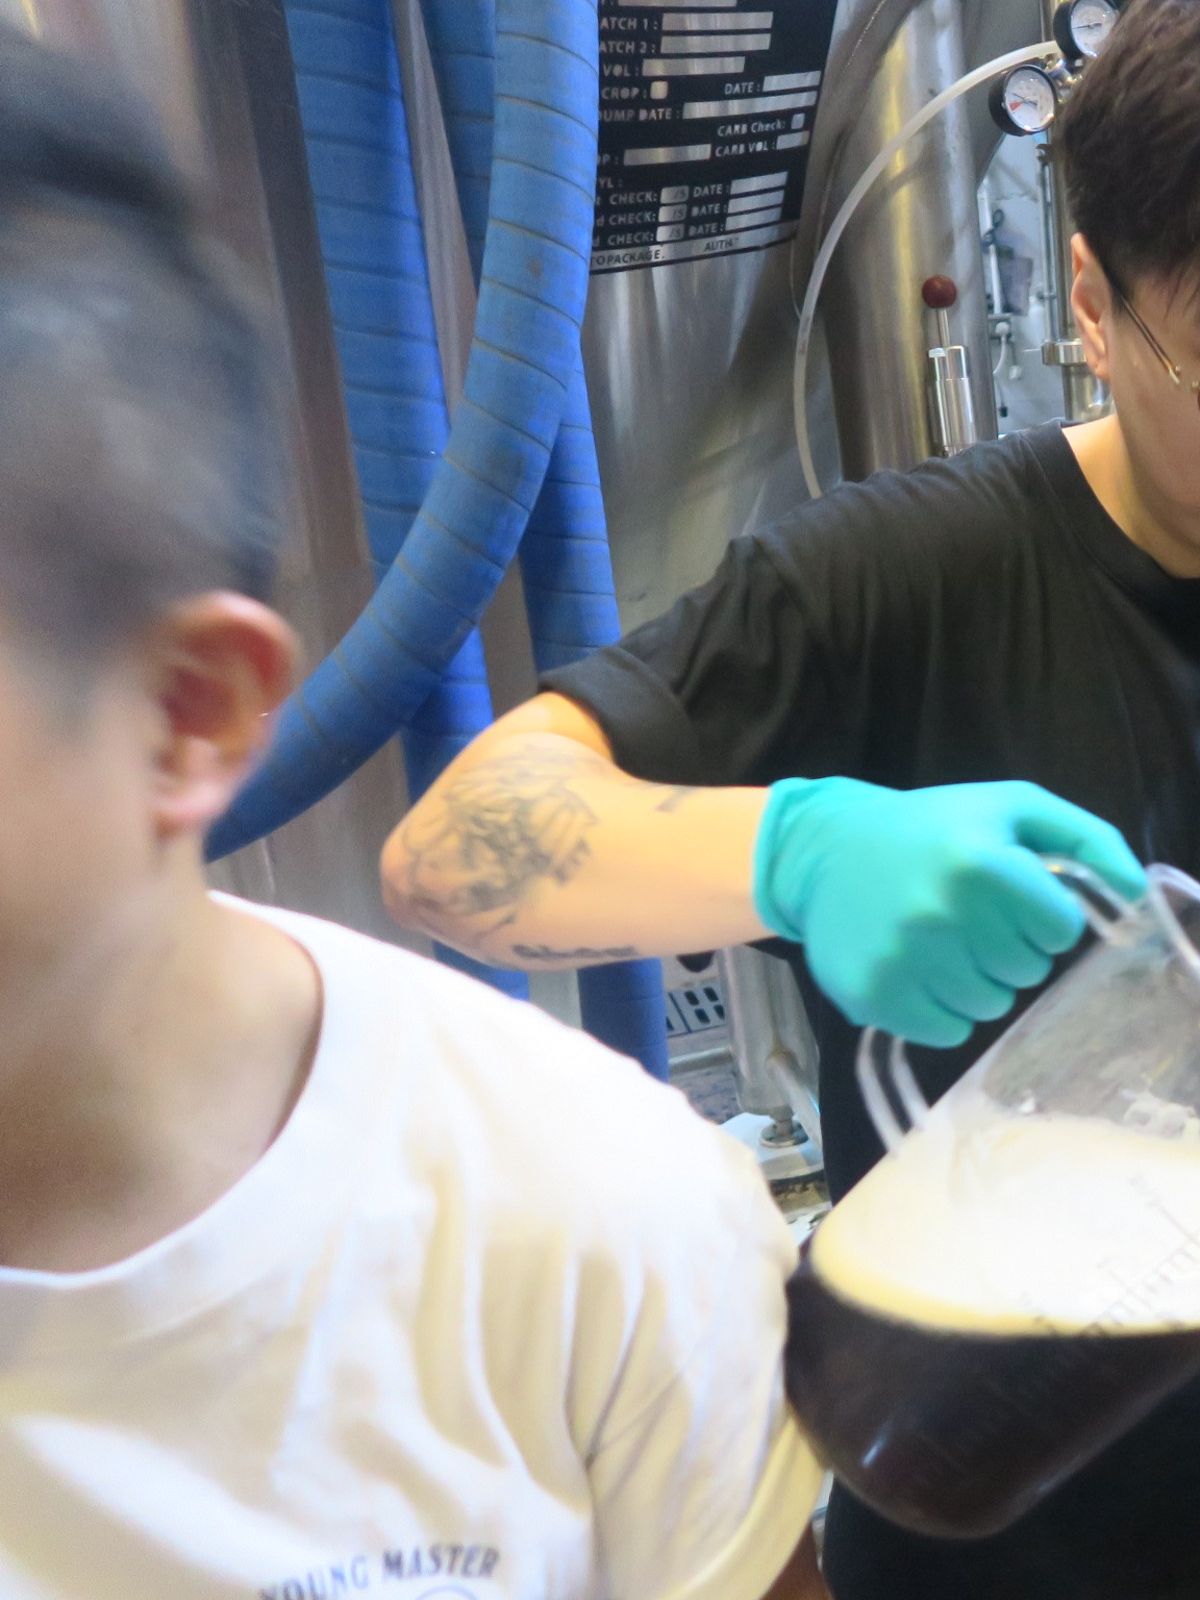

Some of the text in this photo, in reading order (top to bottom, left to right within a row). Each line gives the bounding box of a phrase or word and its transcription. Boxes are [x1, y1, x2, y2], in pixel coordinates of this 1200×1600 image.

[600, 17, 638, 30] ATCH
[600, 41, 636, 54] ATCH
[383, 1543, 500, 1579] MASTER
